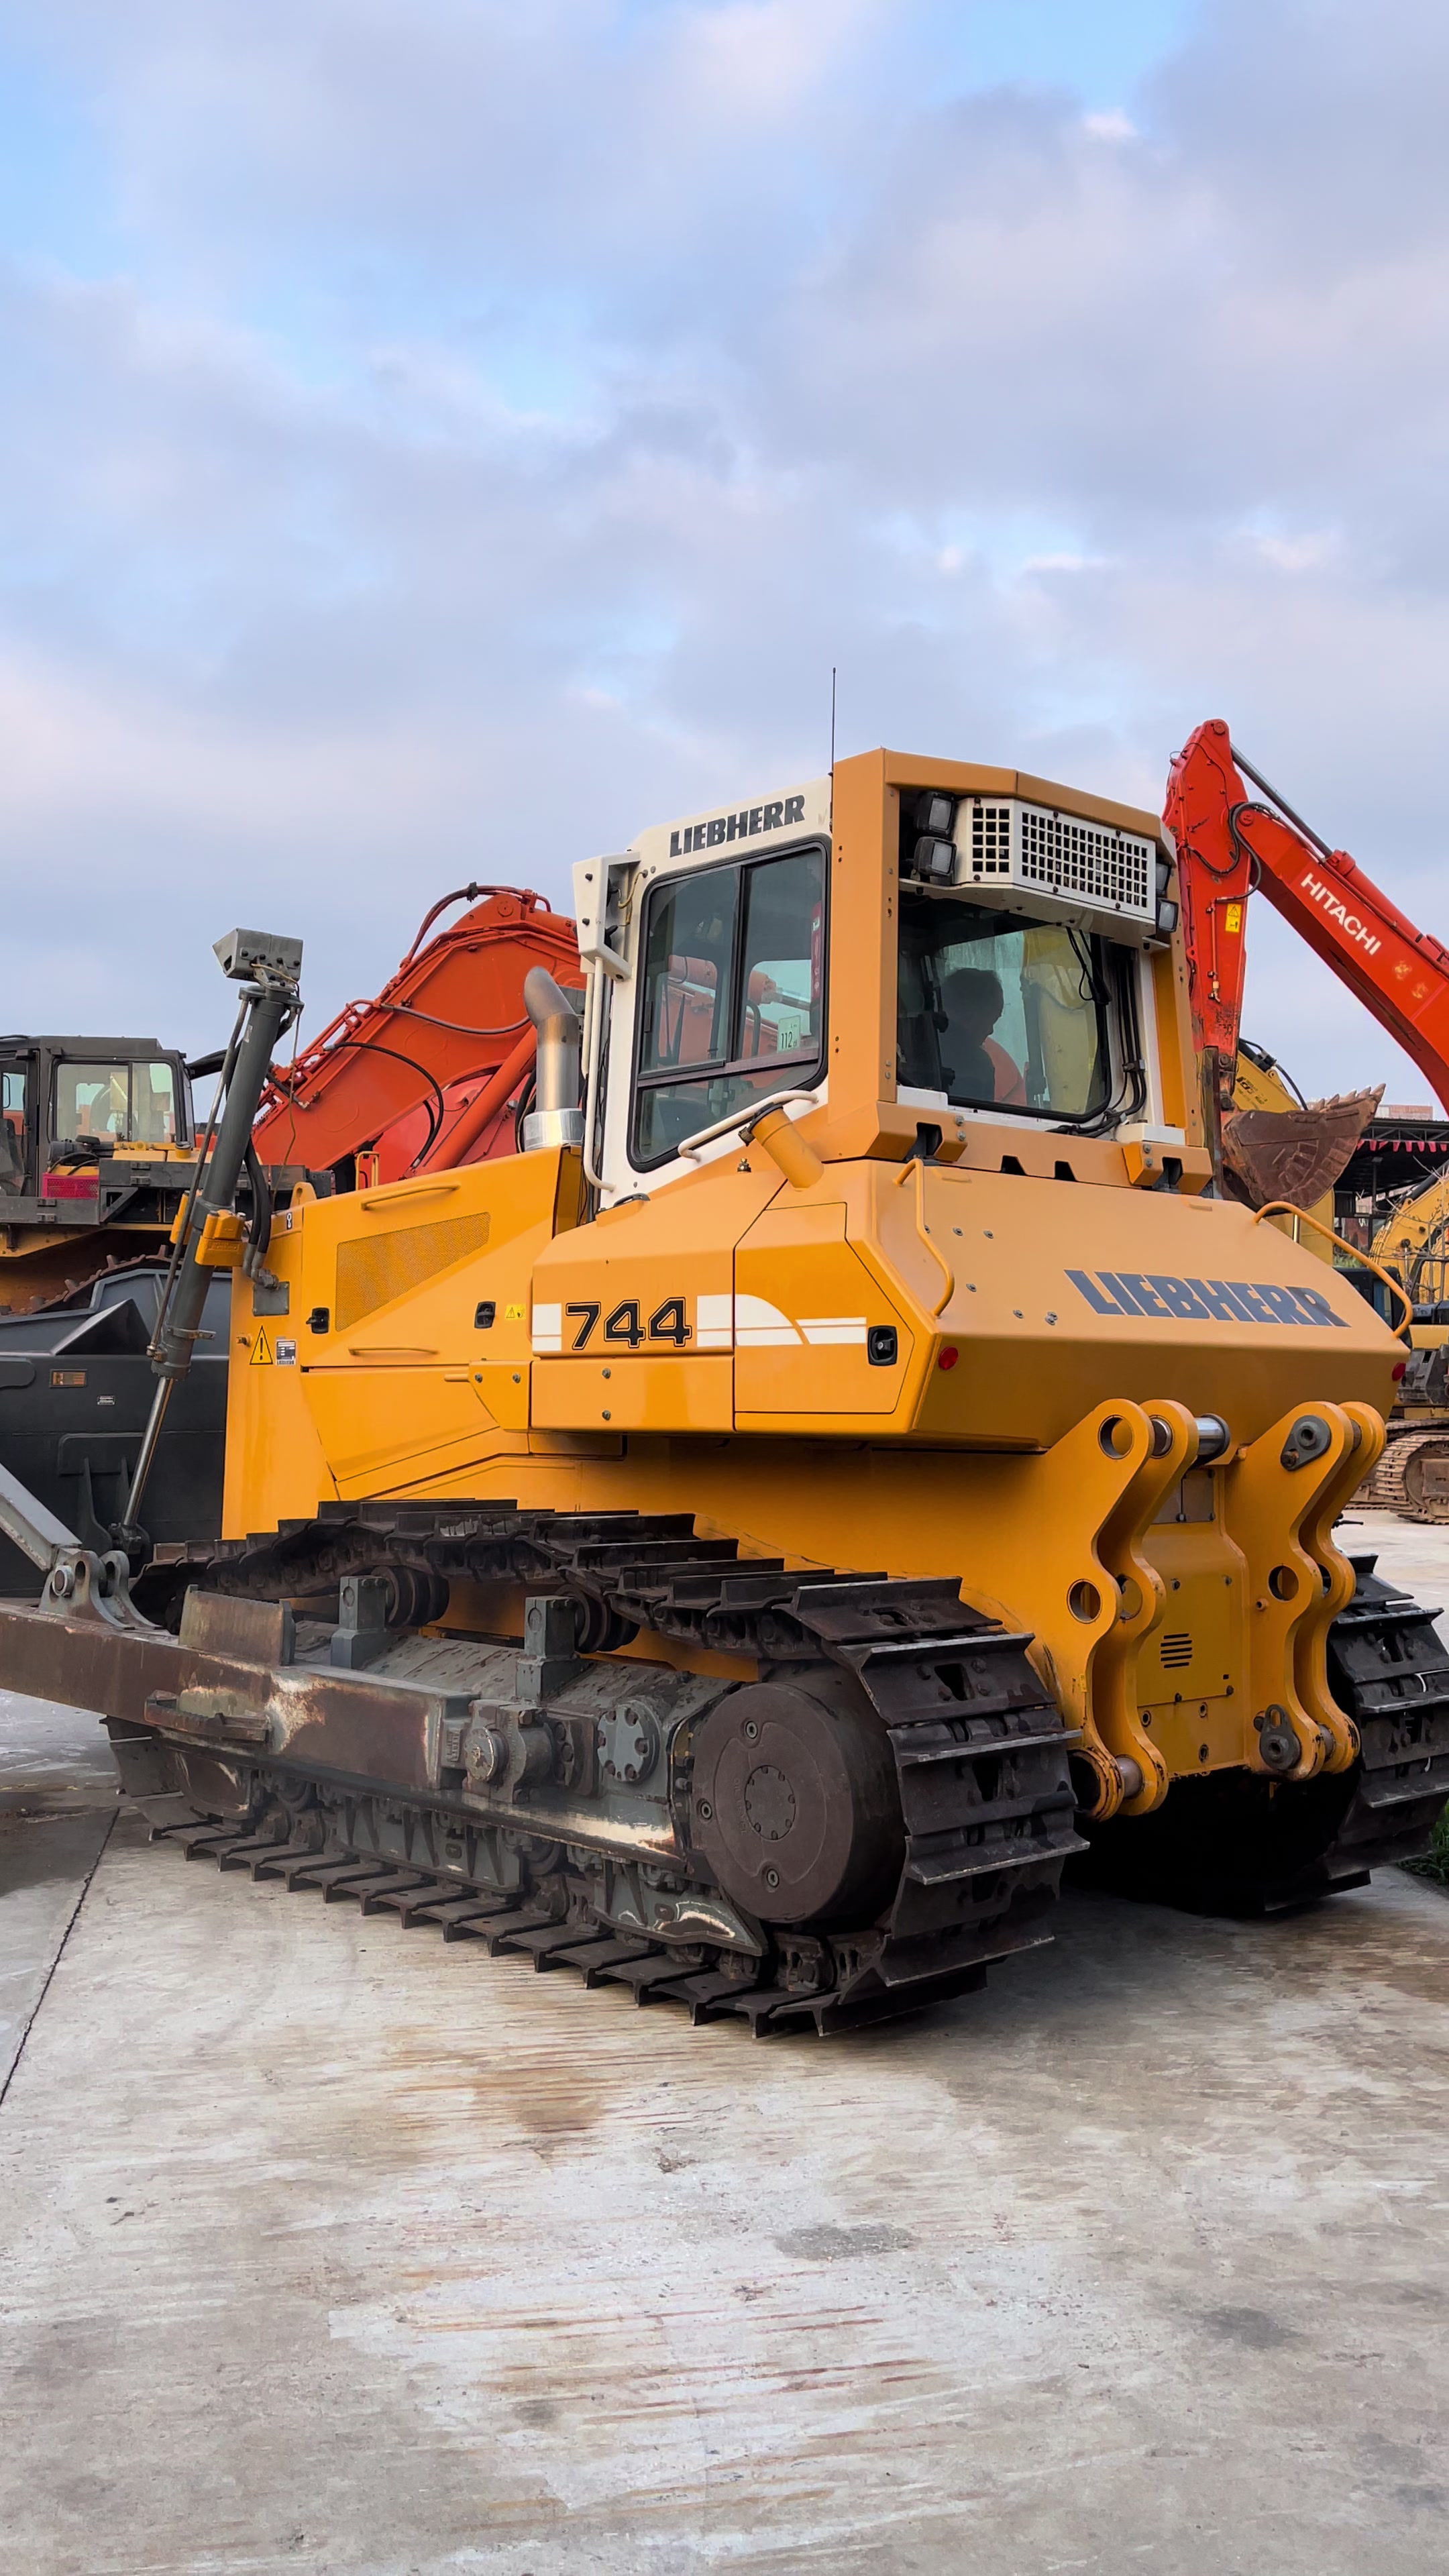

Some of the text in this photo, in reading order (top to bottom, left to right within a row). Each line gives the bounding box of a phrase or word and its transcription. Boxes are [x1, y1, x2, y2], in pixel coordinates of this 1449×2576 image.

[669, 795, 805, 857] LIEBHERR
[1301, 873, 1381, 955] HITACHI
[782, 1032, 792, 1049] 112
[566, 1297, 692, 1350] 744
[1063, 1269, 1352, 1328] LIEBHERR
